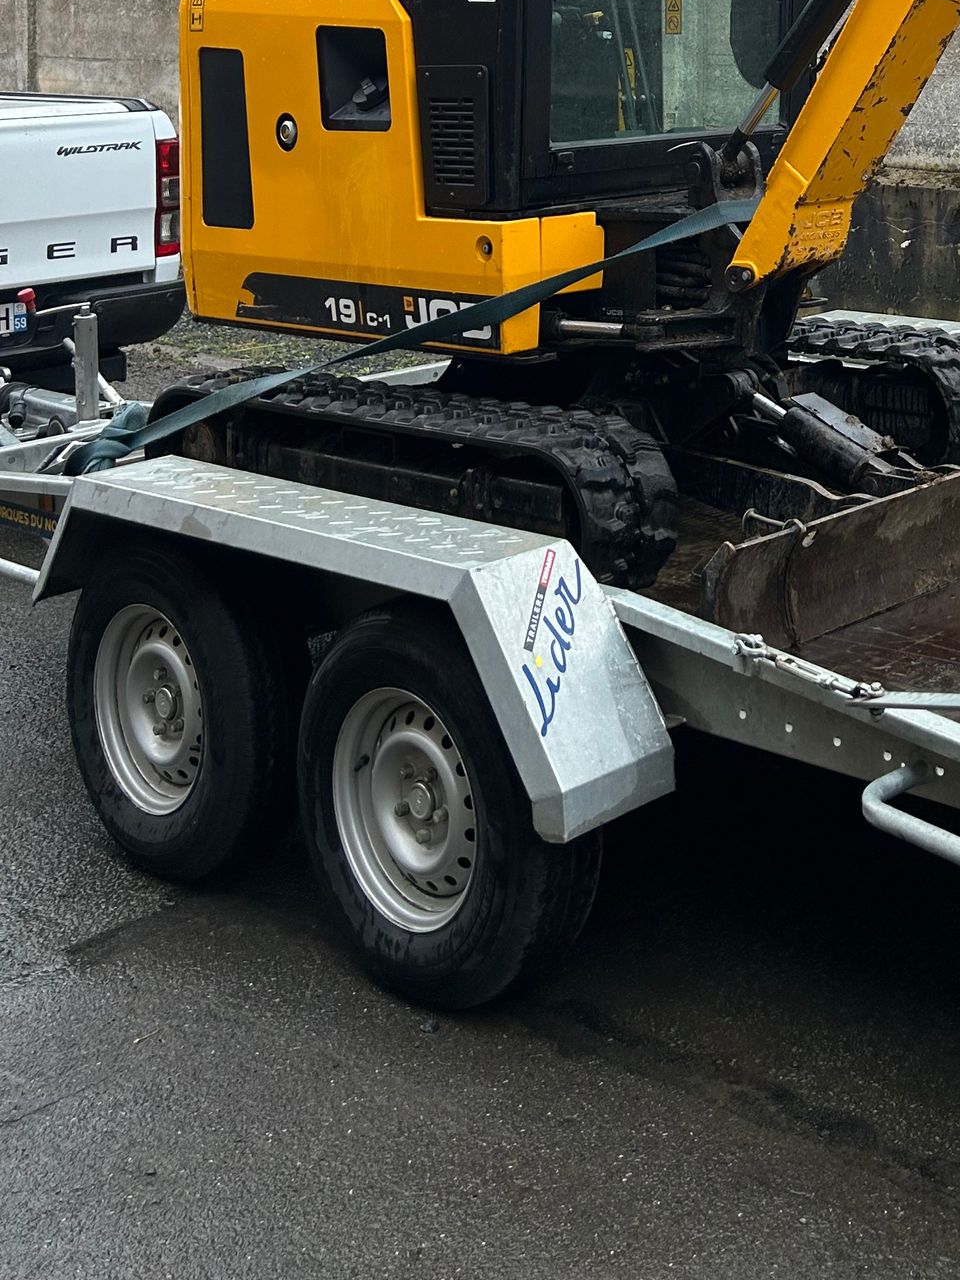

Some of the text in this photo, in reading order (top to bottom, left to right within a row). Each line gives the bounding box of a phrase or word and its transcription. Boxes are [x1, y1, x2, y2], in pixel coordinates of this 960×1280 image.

[56, 141, 143, 157] WILDTRAK
[324, 296, 356, 324] 19
[14, 317, 27, 329] 59
[526, 593, 544, 643] TRAILERS
